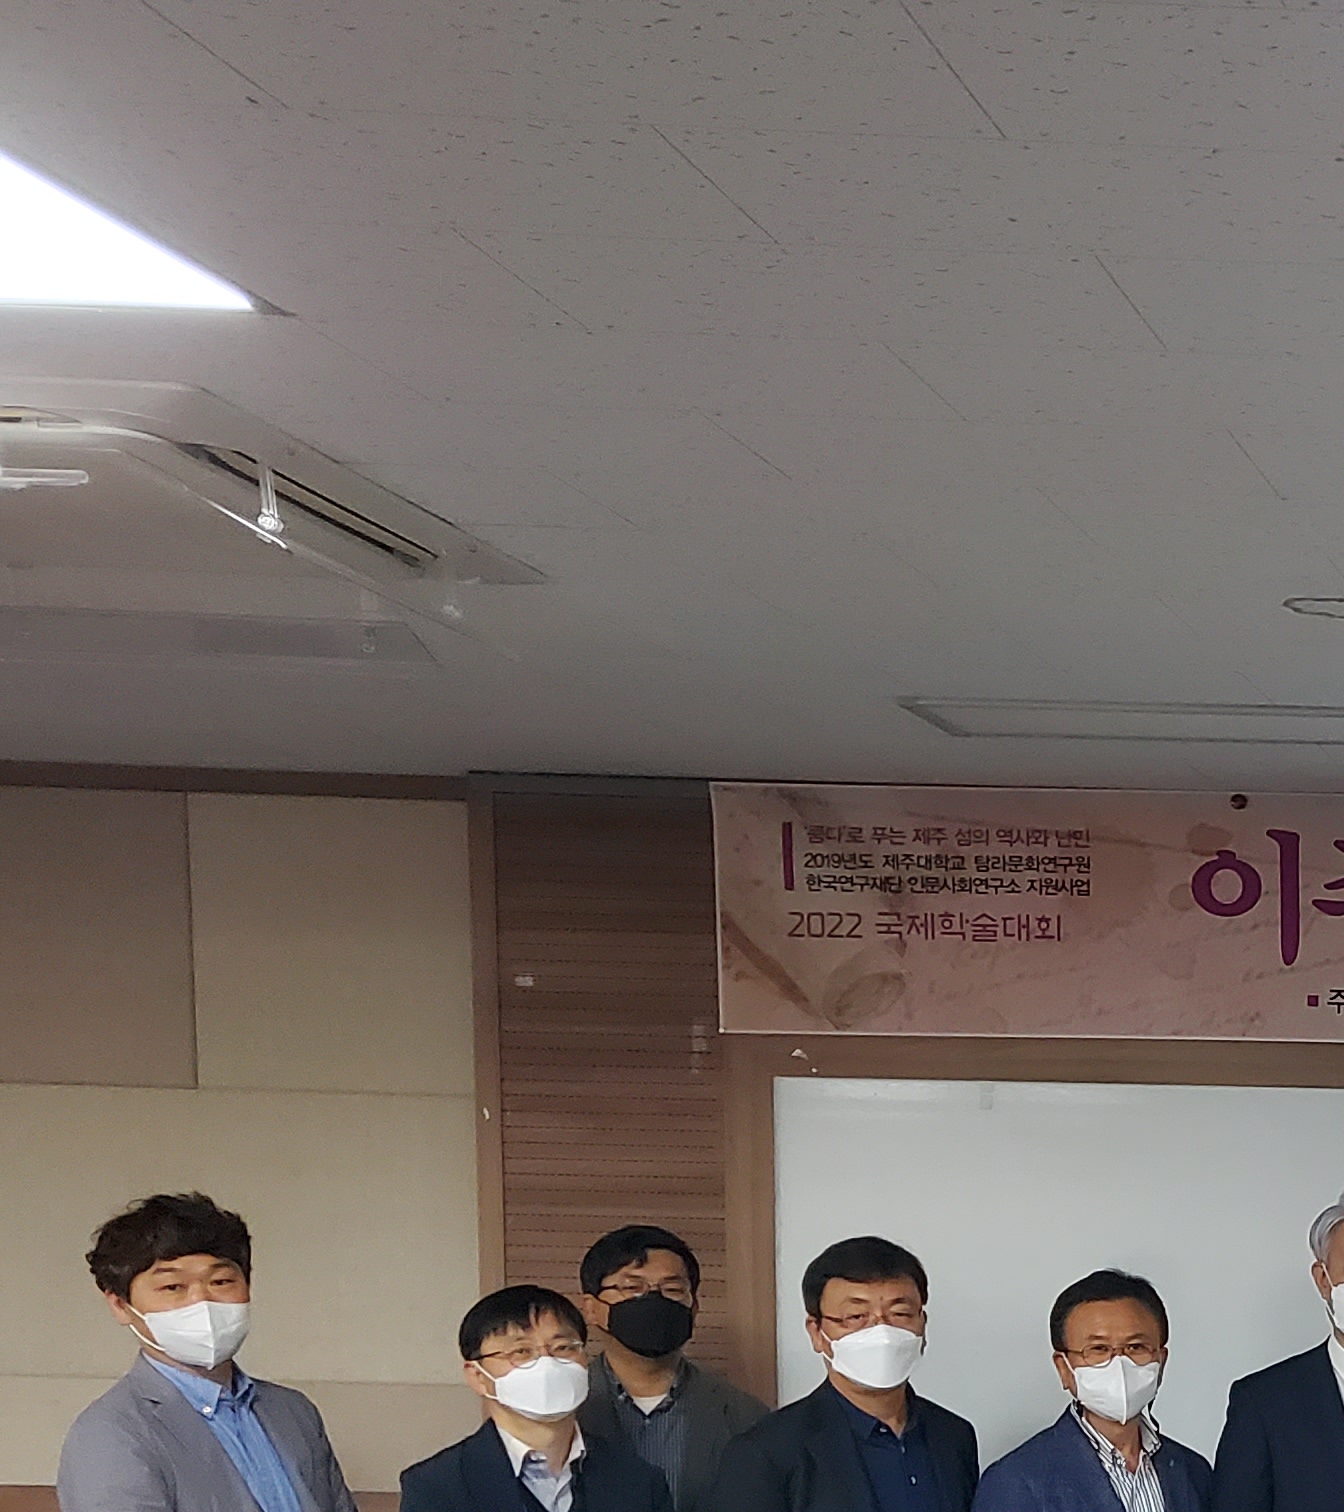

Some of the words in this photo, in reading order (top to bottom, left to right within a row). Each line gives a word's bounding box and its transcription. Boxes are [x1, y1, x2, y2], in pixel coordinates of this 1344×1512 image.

[871, 827, 907, 845] 푸는
[912, 828, 948, 846] 제주
[955, 828, 989, 846] 섬의
[996, 829, 1050, 847] 역사와
[1055, 829, 1091, 848] 난민
[804, 852, 875, 870] 2019년도
[882, 853, 967, 873] 제주대학교
[974, 855, 1091, 874] 탐라문화연구원
[805, 874, 903, 894] 한국연구재단
[907, 875, 1022, 895] 인문사회연구소
[1026, 877, 1091, 897] 지원사업
[788, 911, 863, 939] 2022
[875, 911, 1062, 942] 국제학술대회
